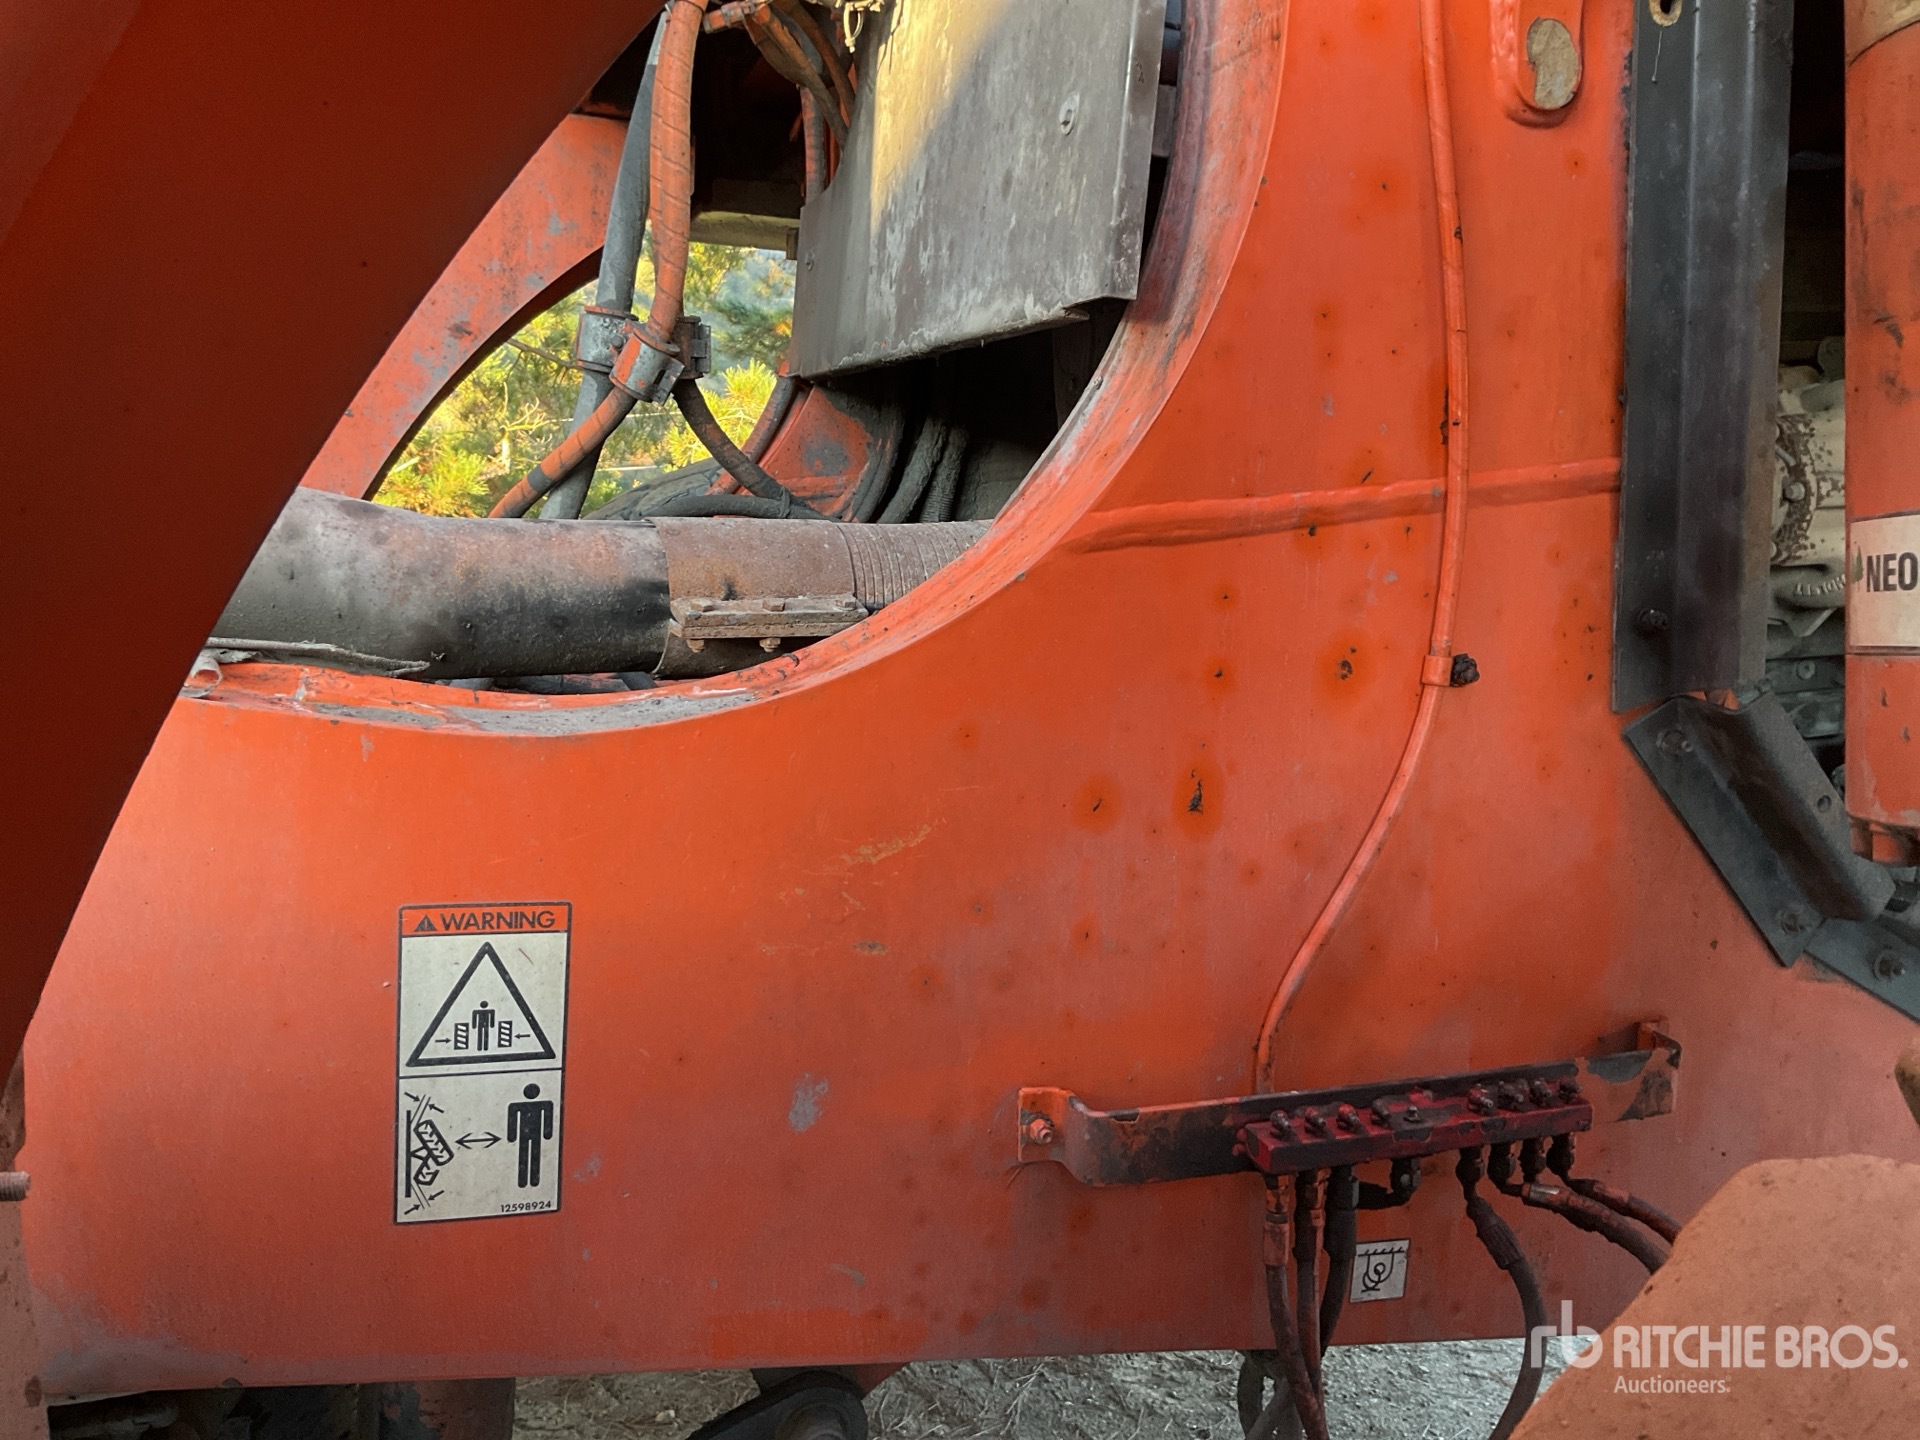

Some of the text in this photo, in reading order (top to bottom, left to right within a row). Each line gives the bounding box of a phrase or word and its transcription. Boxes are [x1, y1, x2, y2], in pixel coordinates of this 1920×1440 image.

[1866, 552, 1918, 592] NEO
[440, 910, 556, 931] WARNING
[501, 1200, 552, 1213] 12598924
